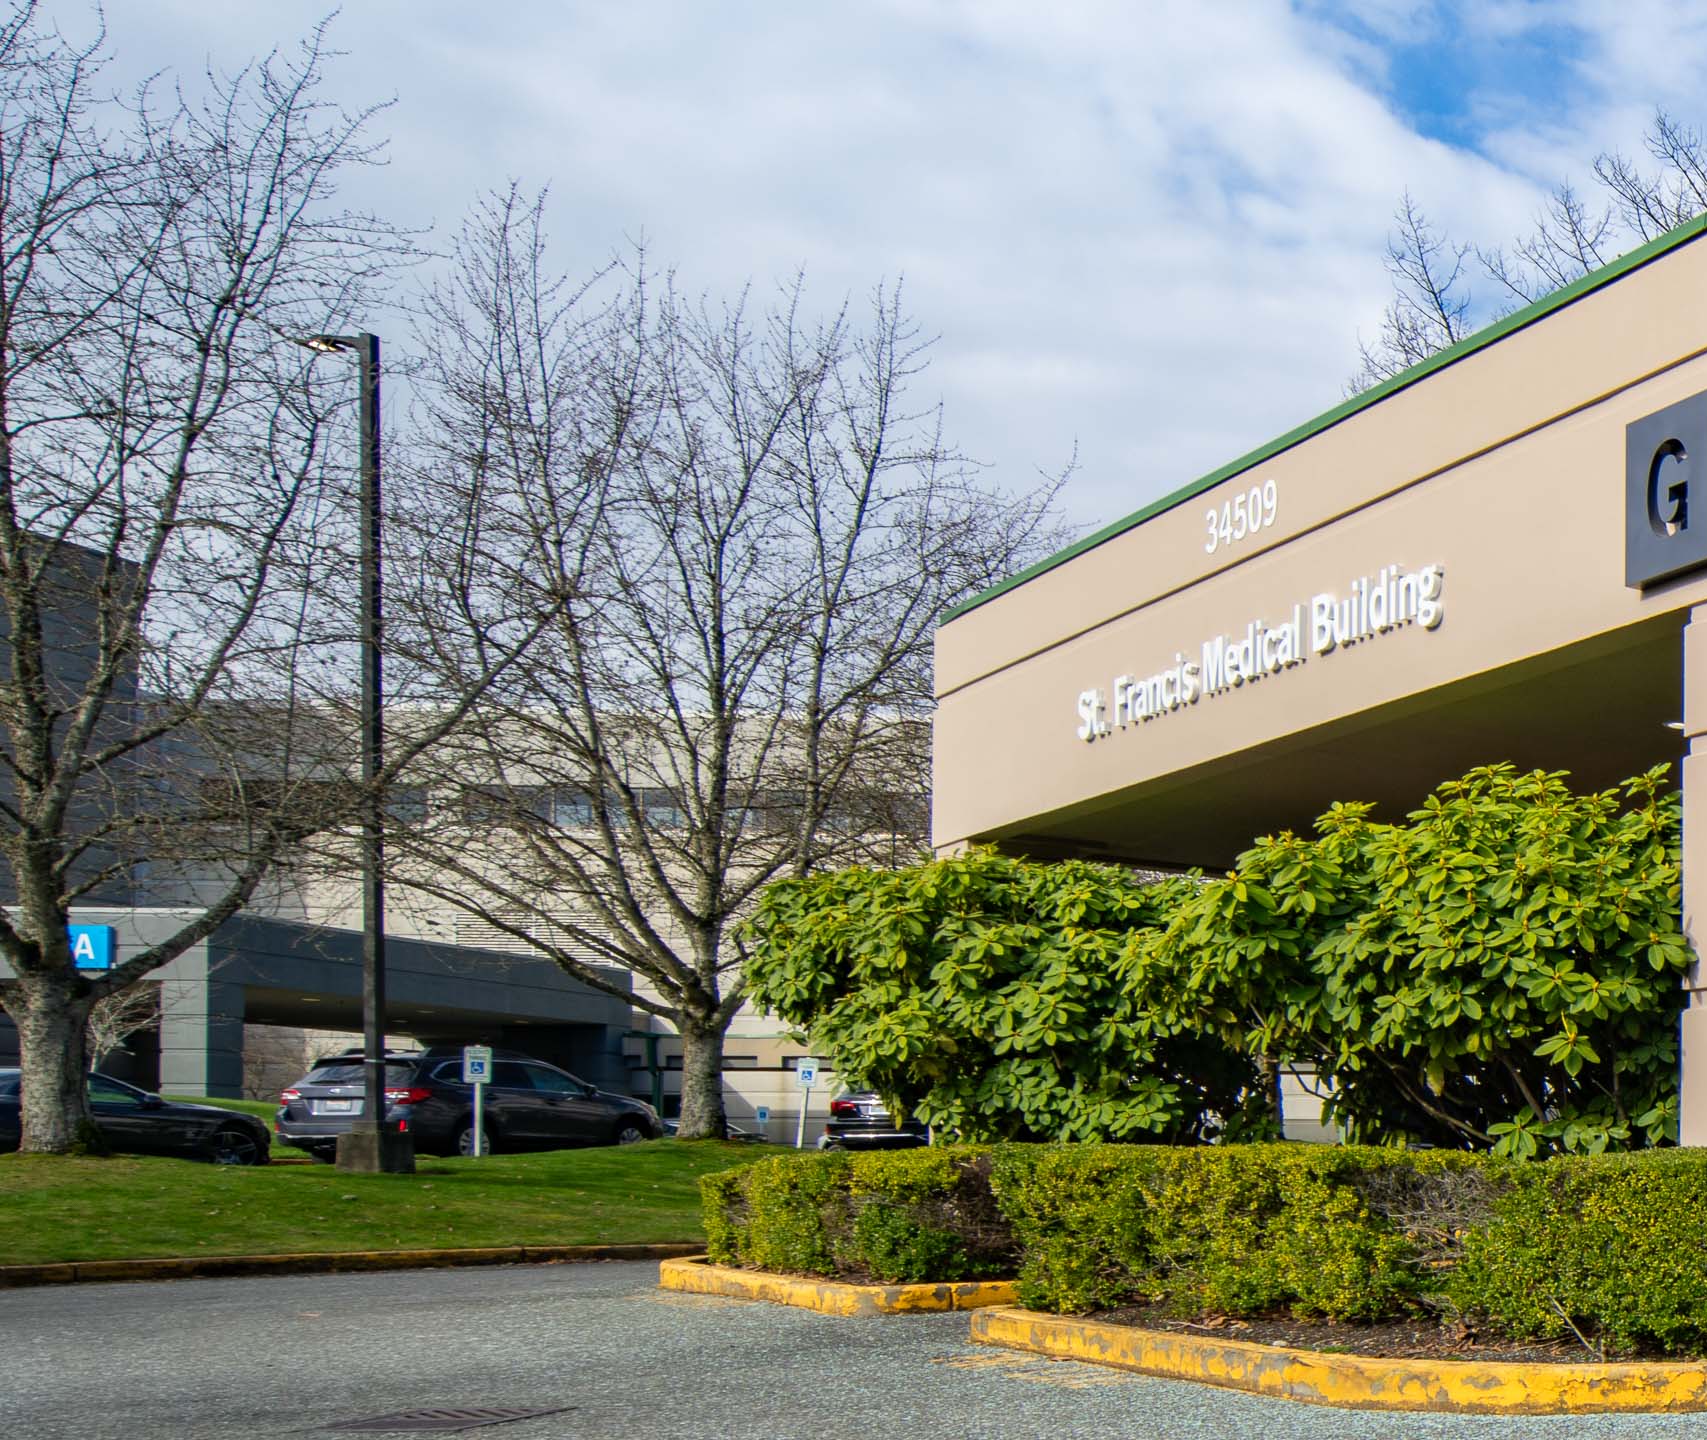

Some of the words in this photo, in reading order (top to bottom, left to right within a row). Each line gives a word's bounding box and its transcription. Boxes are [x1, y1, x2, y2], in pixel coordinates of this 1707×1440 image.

[1205, 480, 1277, 554] 34509
[1647, 437, 1689, 538] G
[1077, 688, 1112, 742] St.
[1113, 653, 1200, 730] Francis
[1202, 604, 1307, 697] Medical
[1311, 564, 1444, 656] Building
